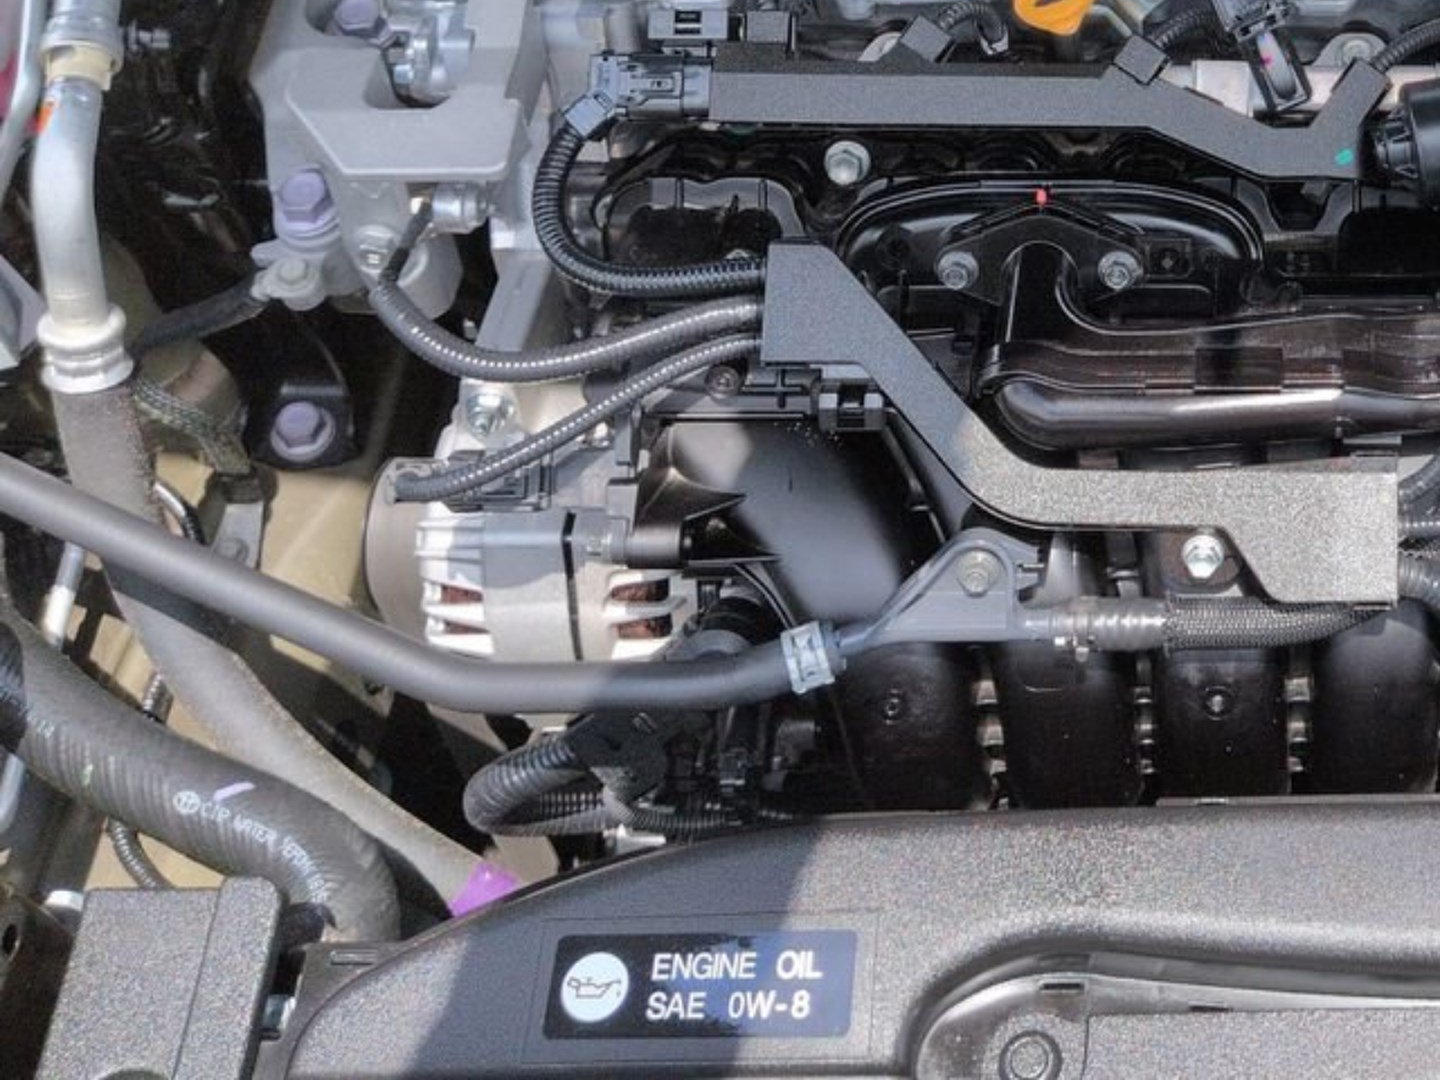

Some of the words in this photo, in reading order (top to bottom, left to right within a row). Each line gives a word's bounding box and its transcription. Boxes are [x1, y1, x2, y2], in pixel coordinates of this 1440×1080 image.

[651, 951, 758, 981] ENGINE
[776, 949, 823, 980] OIL
[645, 990, 707, 1020] SAE
[727, 988, 811, 1019] 0W-8
